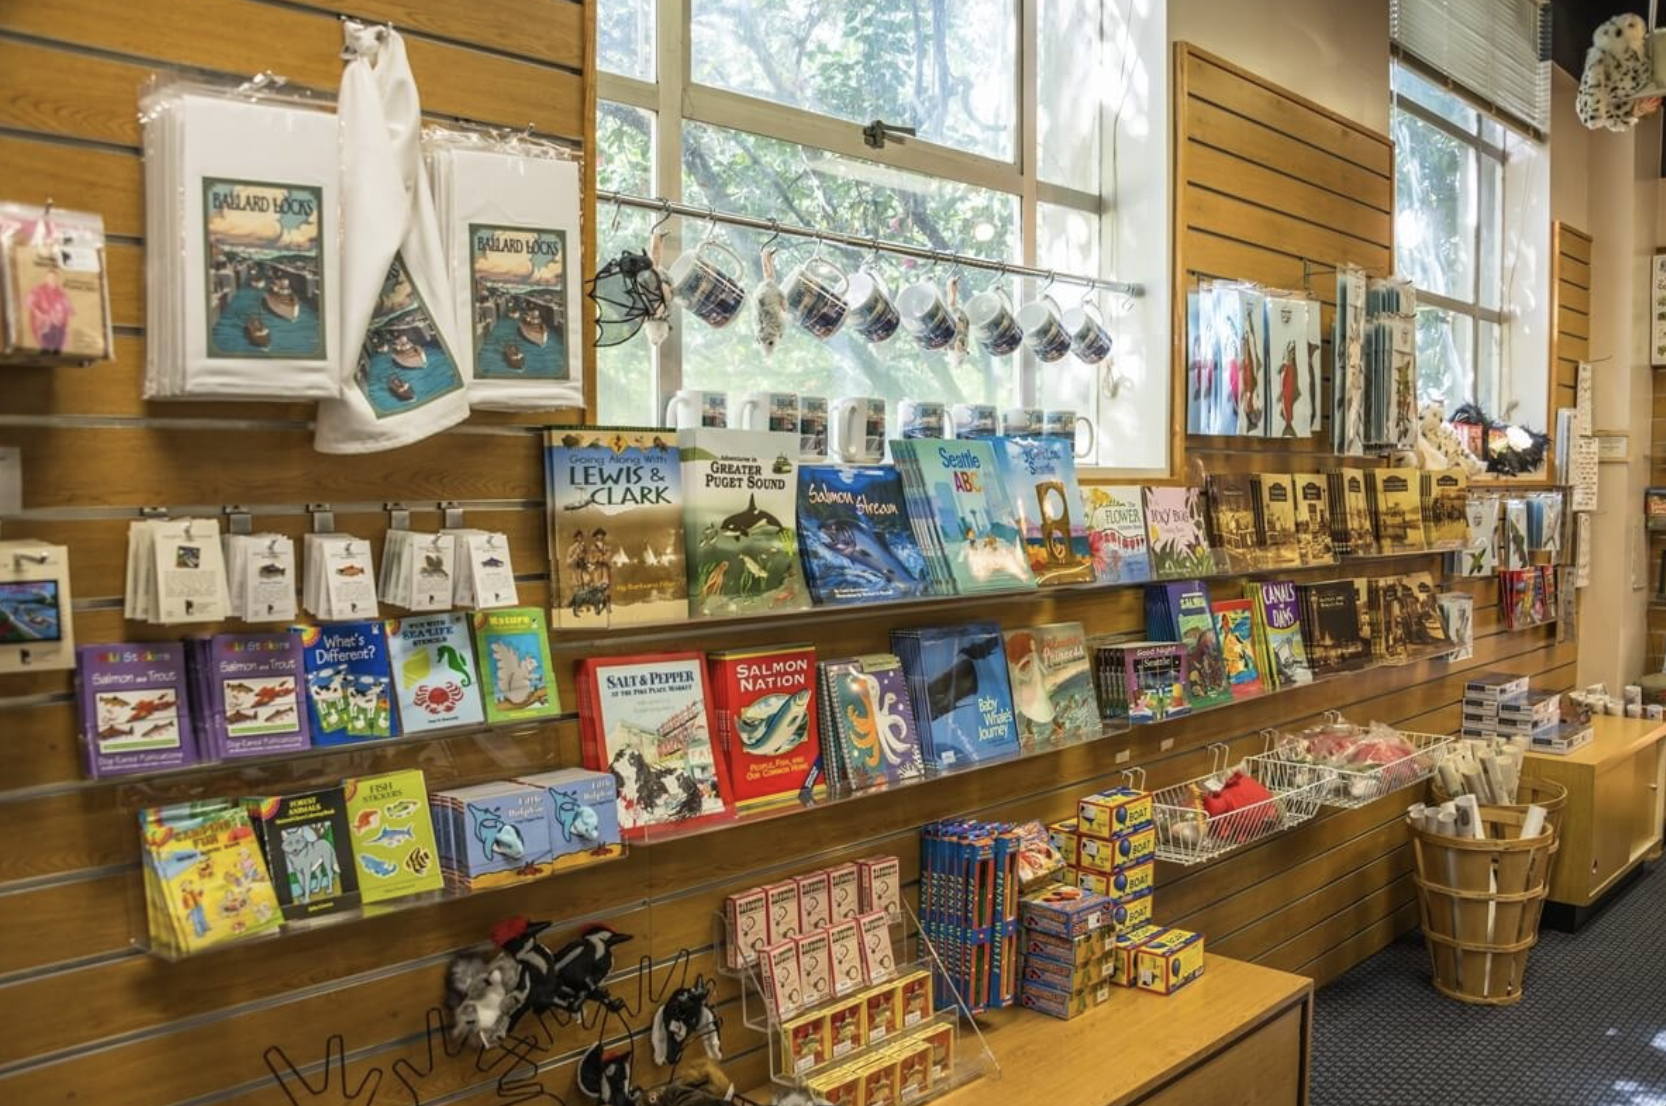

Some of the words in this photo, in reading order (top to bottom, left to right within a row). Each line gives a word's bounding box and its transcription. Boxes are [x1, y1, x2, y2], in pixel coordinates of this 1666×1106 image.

[212, 192, 270, 213] BALLARD
[273, 195, 314, 217] LOCKS
[477, 236, 523, 254] BALLARD
[526, 238, 560, 256] LOCKS
[569, 454, 605, 466] Going
[609, 454, 640, 466] Along
[643, 452, 668, 464] With
[939, 447, 980, 470] Seattle
[569, 466, 645, 486] LEWIS
[650, 467, 666, 482] &
[711, 461, 762, 475] GREATER
[705, 473, 744, 488] PUGET
[747, 475, 786, 490] SOUND
[954, 470, 983, 493] ABC
[590, 486, 673, 506] CLARK
[808, 483, 853, 505] Salmon
[856, 496, 899, 516] Stream
[1105, 508, 1141, 525] FLOWER
[1263, 583, 1295, 605] CANALS
[489, 615, 530, 625] Nature
[1272, 606, 1295, 628] DAMS
[323, 633, 365, 649] What's
[122, 650, 170, 662] Stickers
[315, 645, 376, 665] Different?
[1136, 648, 1155, 657] Good
[220, 660, 257, 673] Salmon
[269, 658, 297, 669] Trout
[736, 659, 808, 679] SALMON
[92, 672, 134, 685] Salmon
[147, 670, 177, 682] Trout
[606, 675, 638, 690] SALT
[639, 674, 648, 686] &
[648, 671, 695, 685] PEPPER
[739, 674, 805, 693] NATION
[977, 698, 998, 713] Baby
[984, 708, 1013, 724] Whale's
[977, 723, 1009, 742] Journey
[369, 782, 394, 794] FISH
[289, 797, 316, 808] FOREST
[362, 790, 403, 803] STICKERS
[288, 803, 321, 815] ANIMALS
[1129, 807, 1148, 823] BOAT
[1132, 840, 1151, 855] BOAT
[1129, 875, 1149, 890] BOAT
[1129, 906, 1148, 921] BOAT
